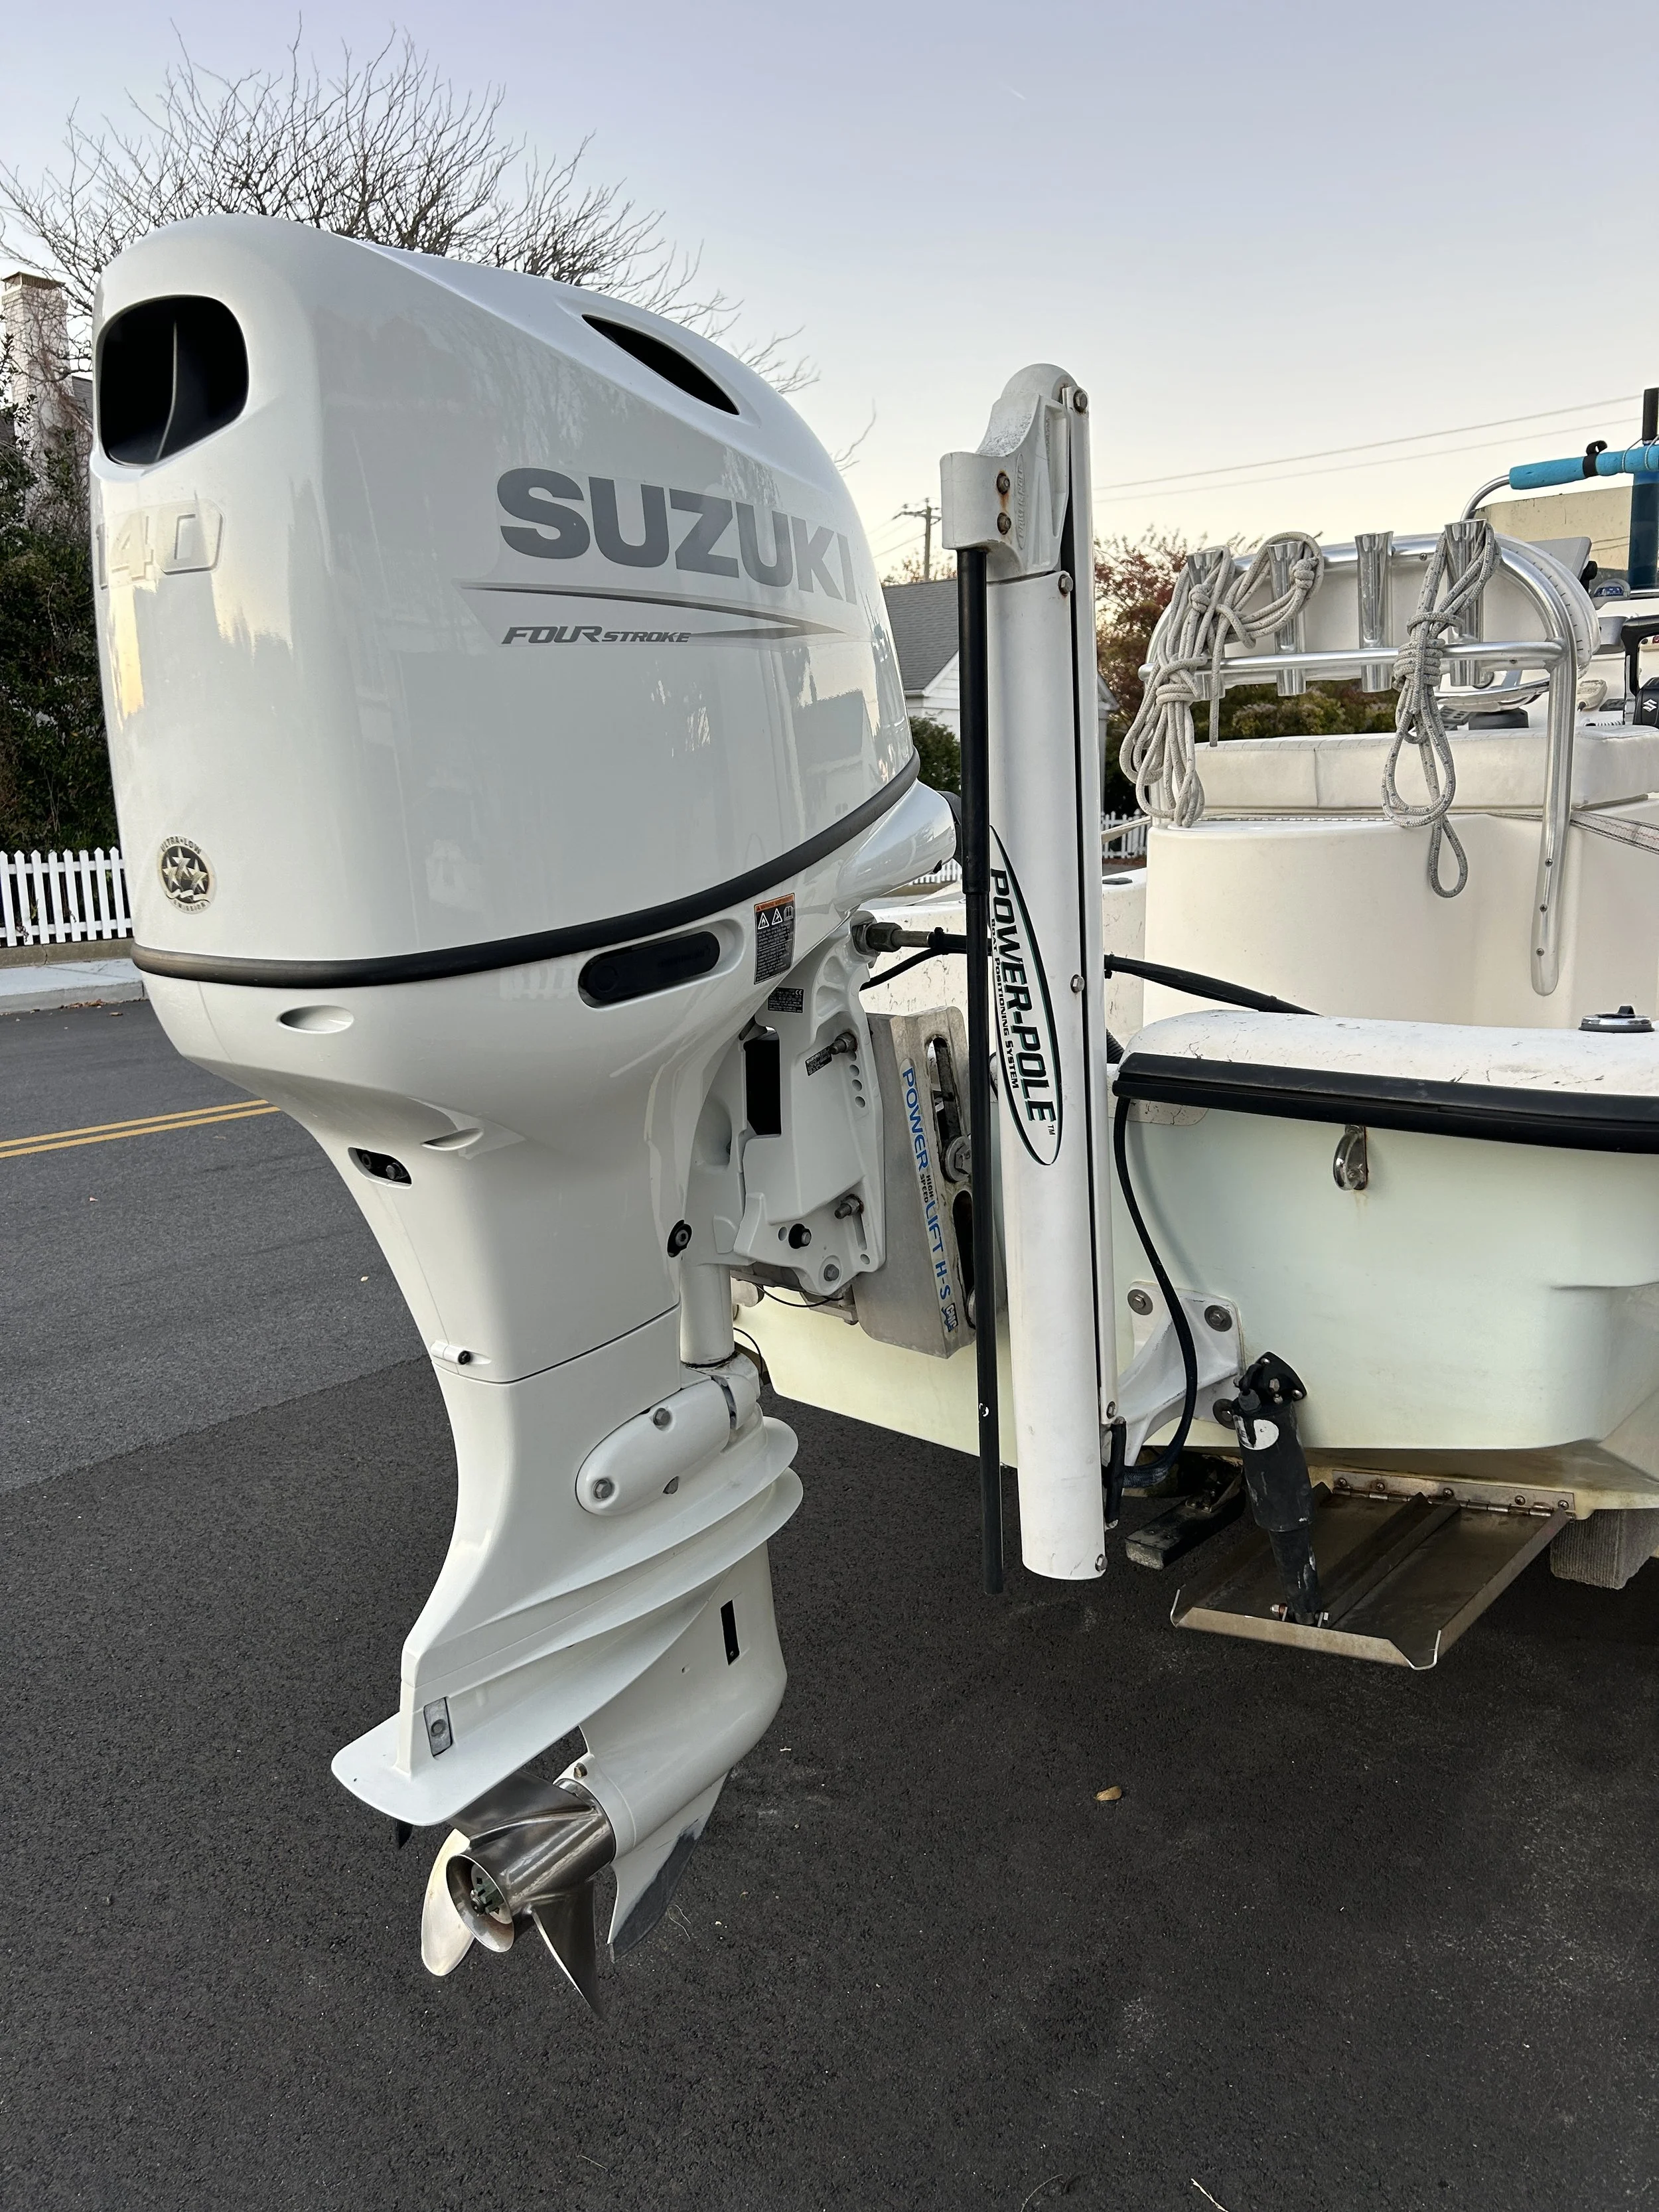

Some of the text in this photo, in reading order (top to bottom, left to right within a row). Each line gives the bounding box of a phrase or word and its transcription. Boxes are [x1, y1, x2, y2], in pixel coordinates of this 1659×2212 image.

[496, 467, 857, 605] SUZUKI
[991, 868, 1057, 1122] POWER-POLE
[994, 957, 1010, 1037] POSITIONING
[1005, 1040, 1019, 1089] SYSTEM
[902, 1067, 951, 1300] POWER LIFT H-S
[920, 1173, 929, 1203] SPEED
